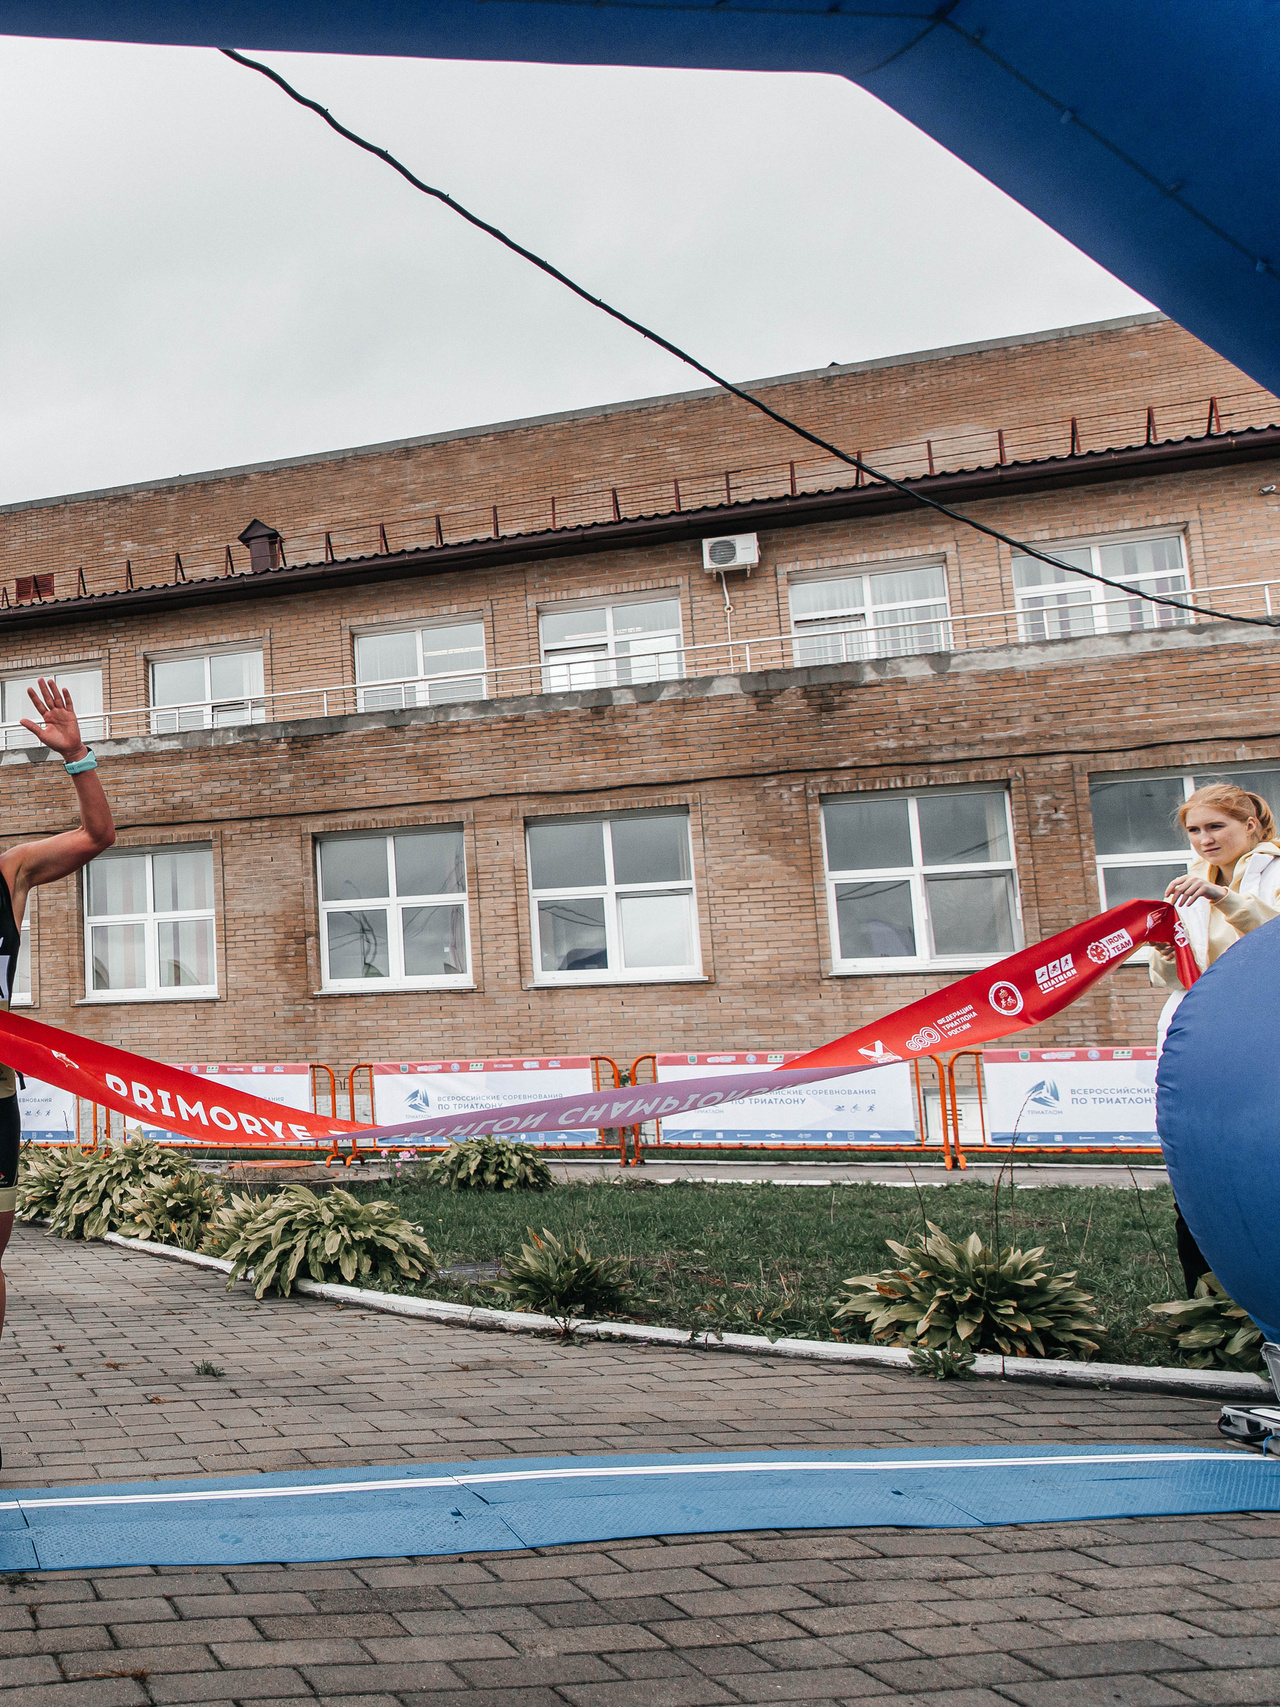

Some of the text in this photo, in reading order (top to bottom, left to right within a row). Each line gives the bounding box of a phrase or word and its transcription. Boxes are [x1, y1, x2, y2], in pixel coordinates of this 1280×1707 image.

[1105, 932, 1126, 946] IRON
[1111, 939, 1132, 955] TEAM
[1038, 968, 1078, 992] TRIATHLON
[936, 1004, 974, 1026] ФЕДЕРАЦИЯ
[941, 1010, 978, 1031] ТРИАТЛОНА
[947, 1022, 972, 1038] РОССИИ
[437, 1092, 564, 1102] ВСЕРОССИЙСКИЕ СОРЕВНОВАНИЯ
[806, 1088, 877, 1096] СОРЕВНОВАНИЯ
[1070, 1086, 1156, 1095] ВСЕРОССИЙСКИЕ
[105, 1073, 312, 1140] PRIMORYE
[731, 1097, 806, 1105] ПО ТРИАТЛОНУ
[1072, 1096, 1088, 1105] ПО
